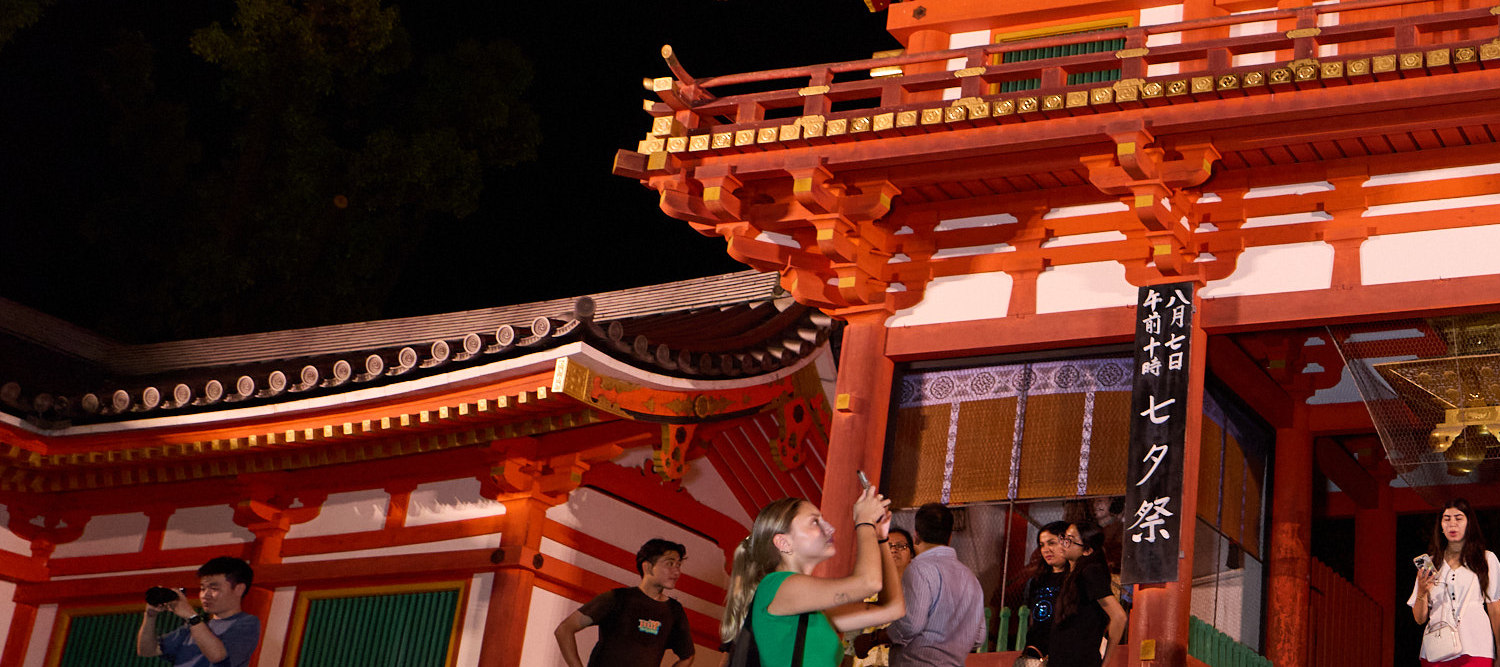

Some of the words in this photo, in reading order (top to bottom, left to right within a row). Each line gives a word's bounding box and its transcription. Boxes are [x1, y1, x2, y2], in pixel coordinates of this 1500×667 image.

[1142, 289, 1163, 376] 午前十時
[1165, 289, 1191, 371] 八月七日
[1127, 395, 1176, 542] 七夕祭
